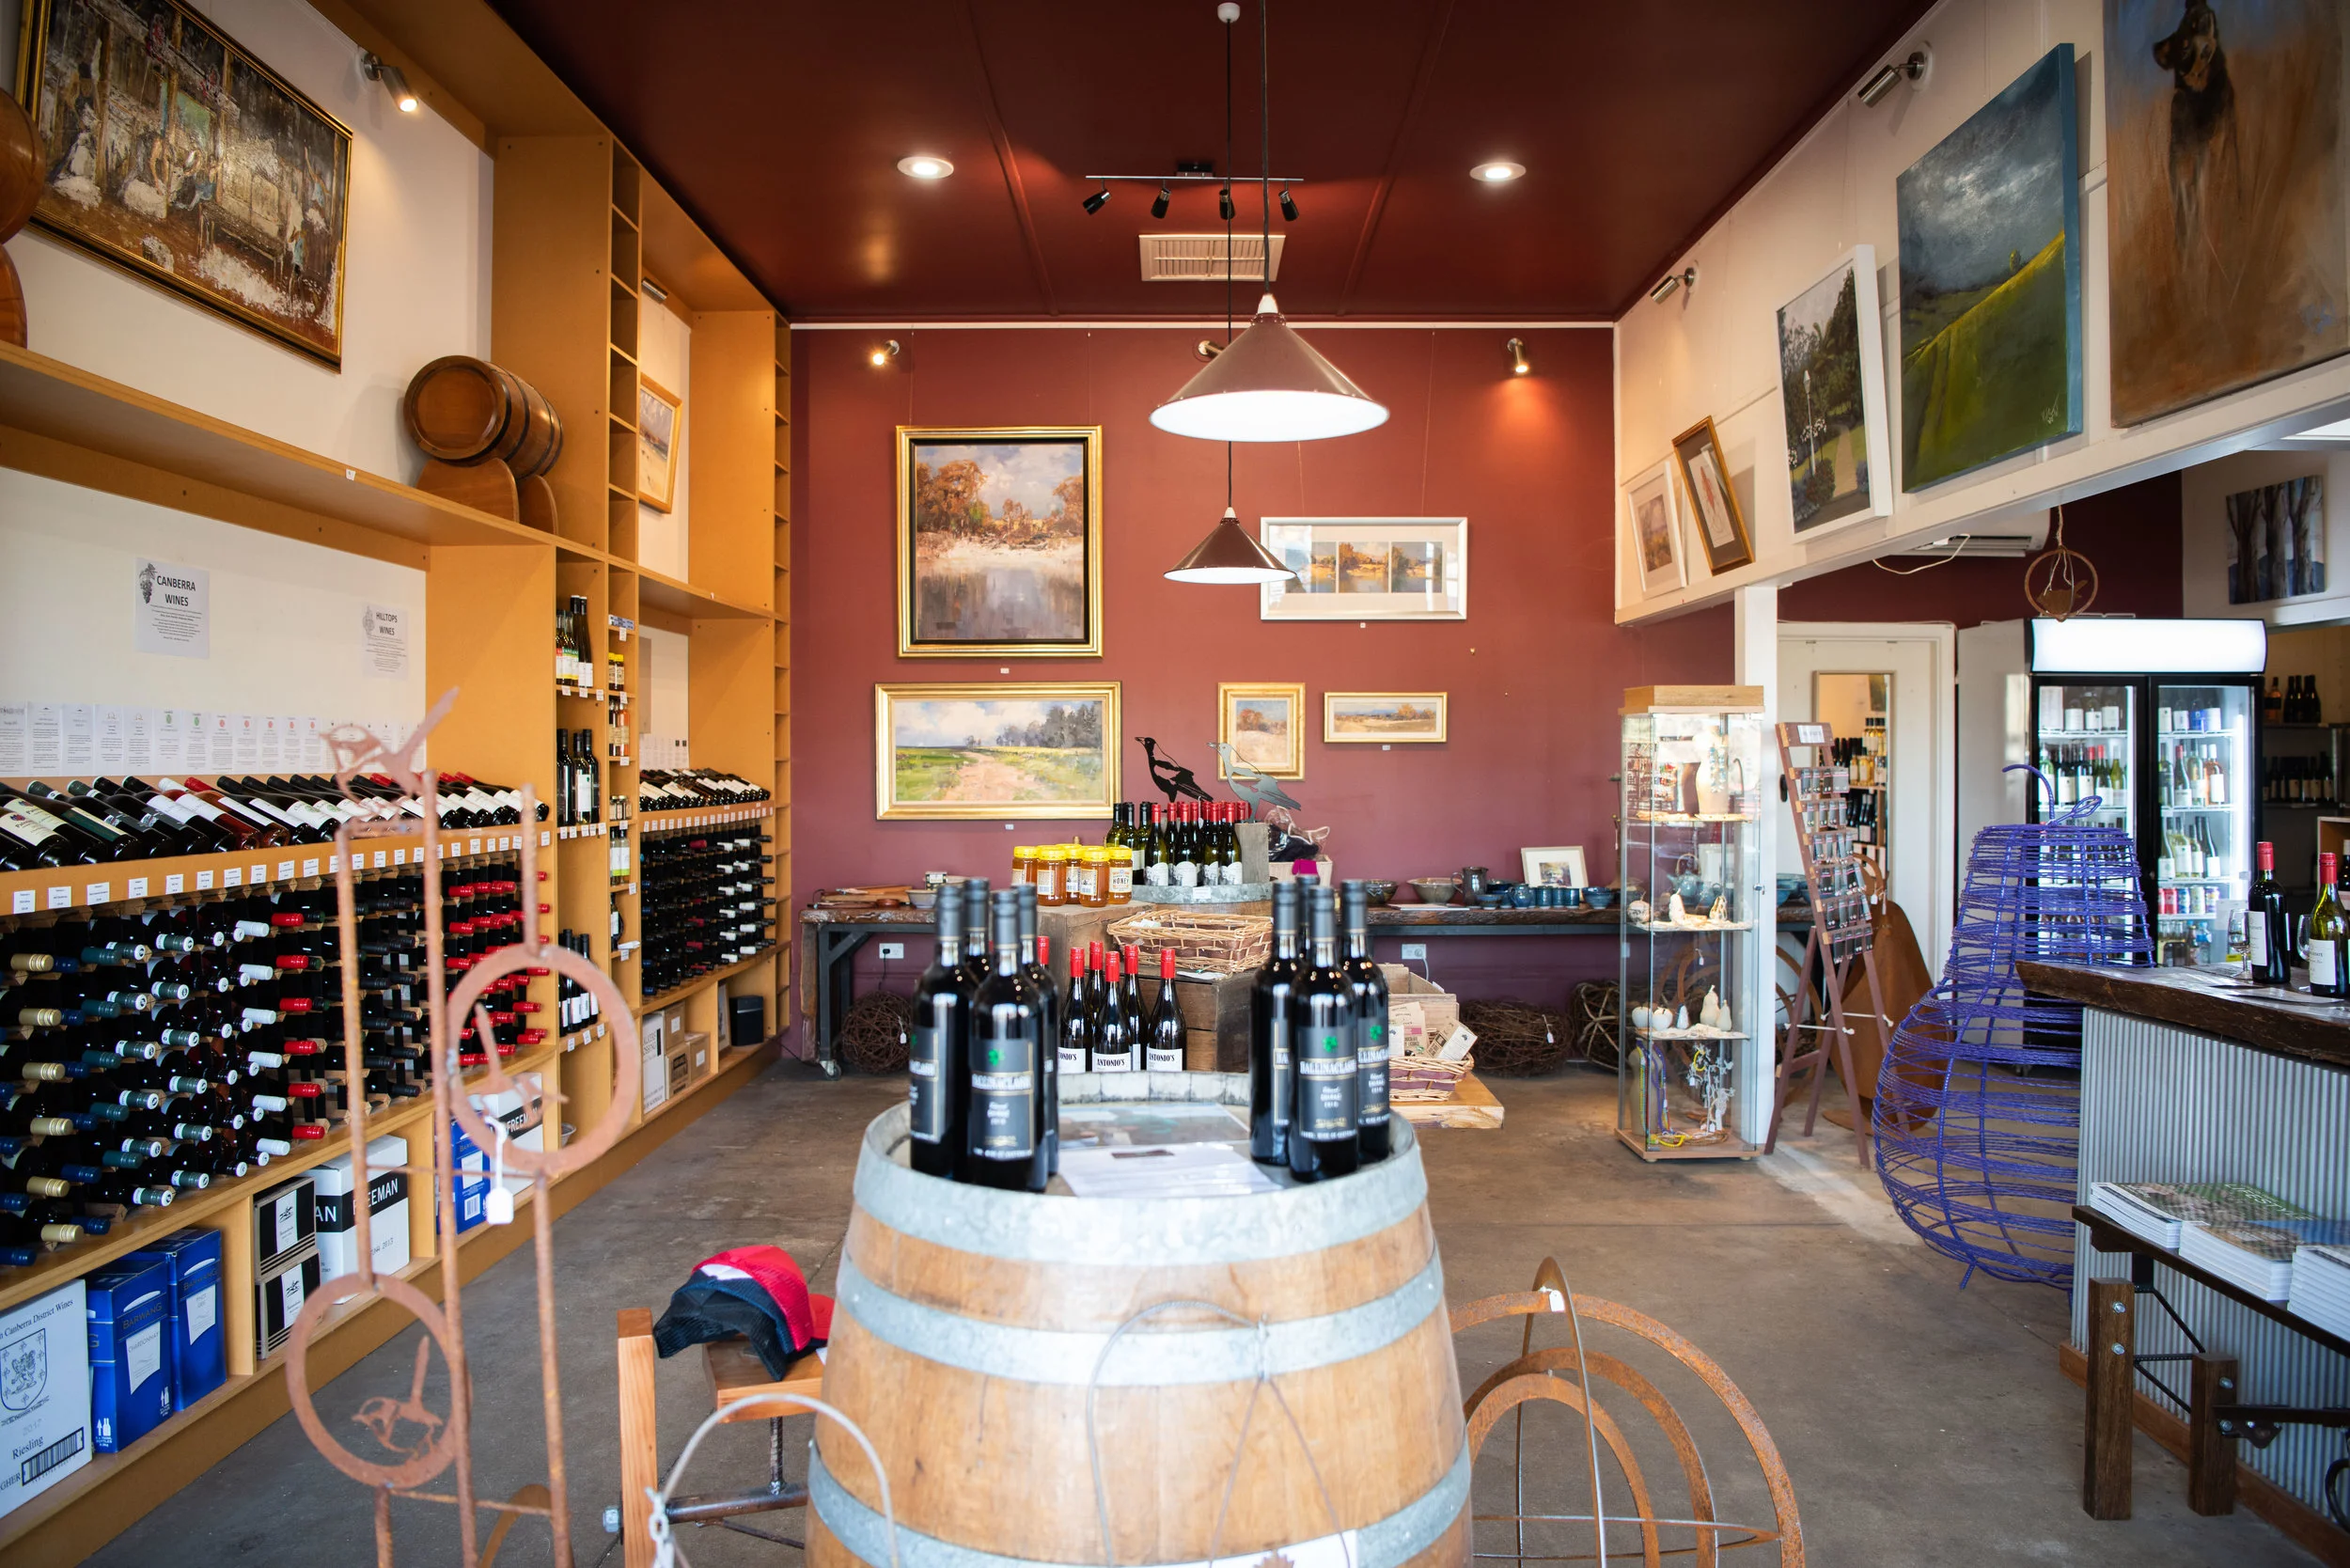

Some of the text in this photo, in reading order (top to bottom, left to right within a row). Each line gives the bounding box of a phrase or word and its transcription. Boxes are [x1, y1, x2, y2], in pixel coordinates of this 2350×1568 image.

[156, 575, 196, 591] CANBERRA
[164, 593, 189, 607] WINES
[376, 612, 399, 623] HILLTOPS
[379, 626, 395, 635] WINES
[1097, 1058, 1125, 1068] ANTONIO'S
[1149, 1052, 1175, 1062] ANTONIO'S
[2224, 1184, 2314, 1220] LIFESTYLE
[4, 1319, 32, 1337] Canberra
[33, 1307, 55, 1324] District
[55, 1299, 74, 1311] Wines
[122, 1302, 162, 1330] BARWANG
[128, 1331, 159, 1354] CHARDONNAY
[12, 1435, 44, 1460] Riesling
